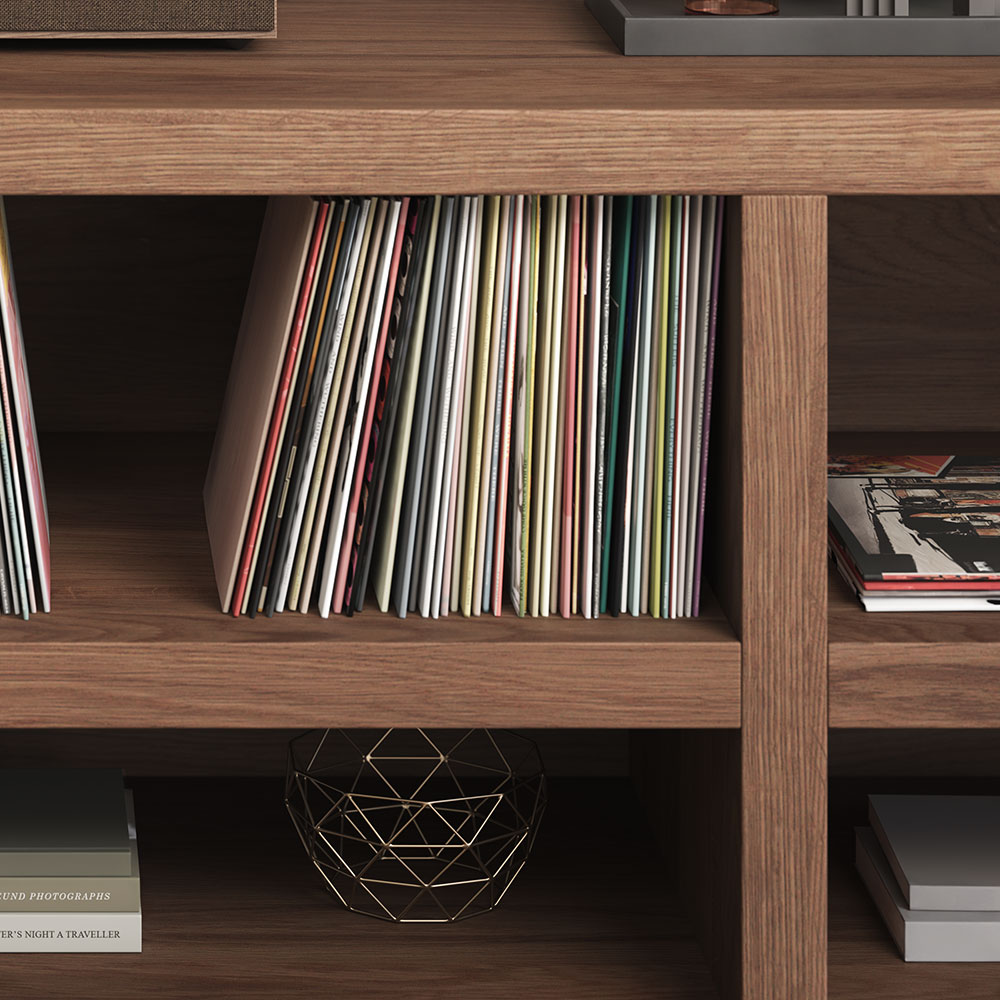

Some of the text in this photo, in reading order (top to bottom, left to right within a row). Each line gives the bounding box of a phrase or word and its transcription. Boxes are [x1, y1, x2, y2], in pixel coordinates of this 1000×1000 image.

[30, 892, 111, 901] PHOTOGRAPHS
[25, 931, 54, 939] NIGHT
[57, 931, 64, 939] A
[65, 931, 121, 939] TRAVELLER
